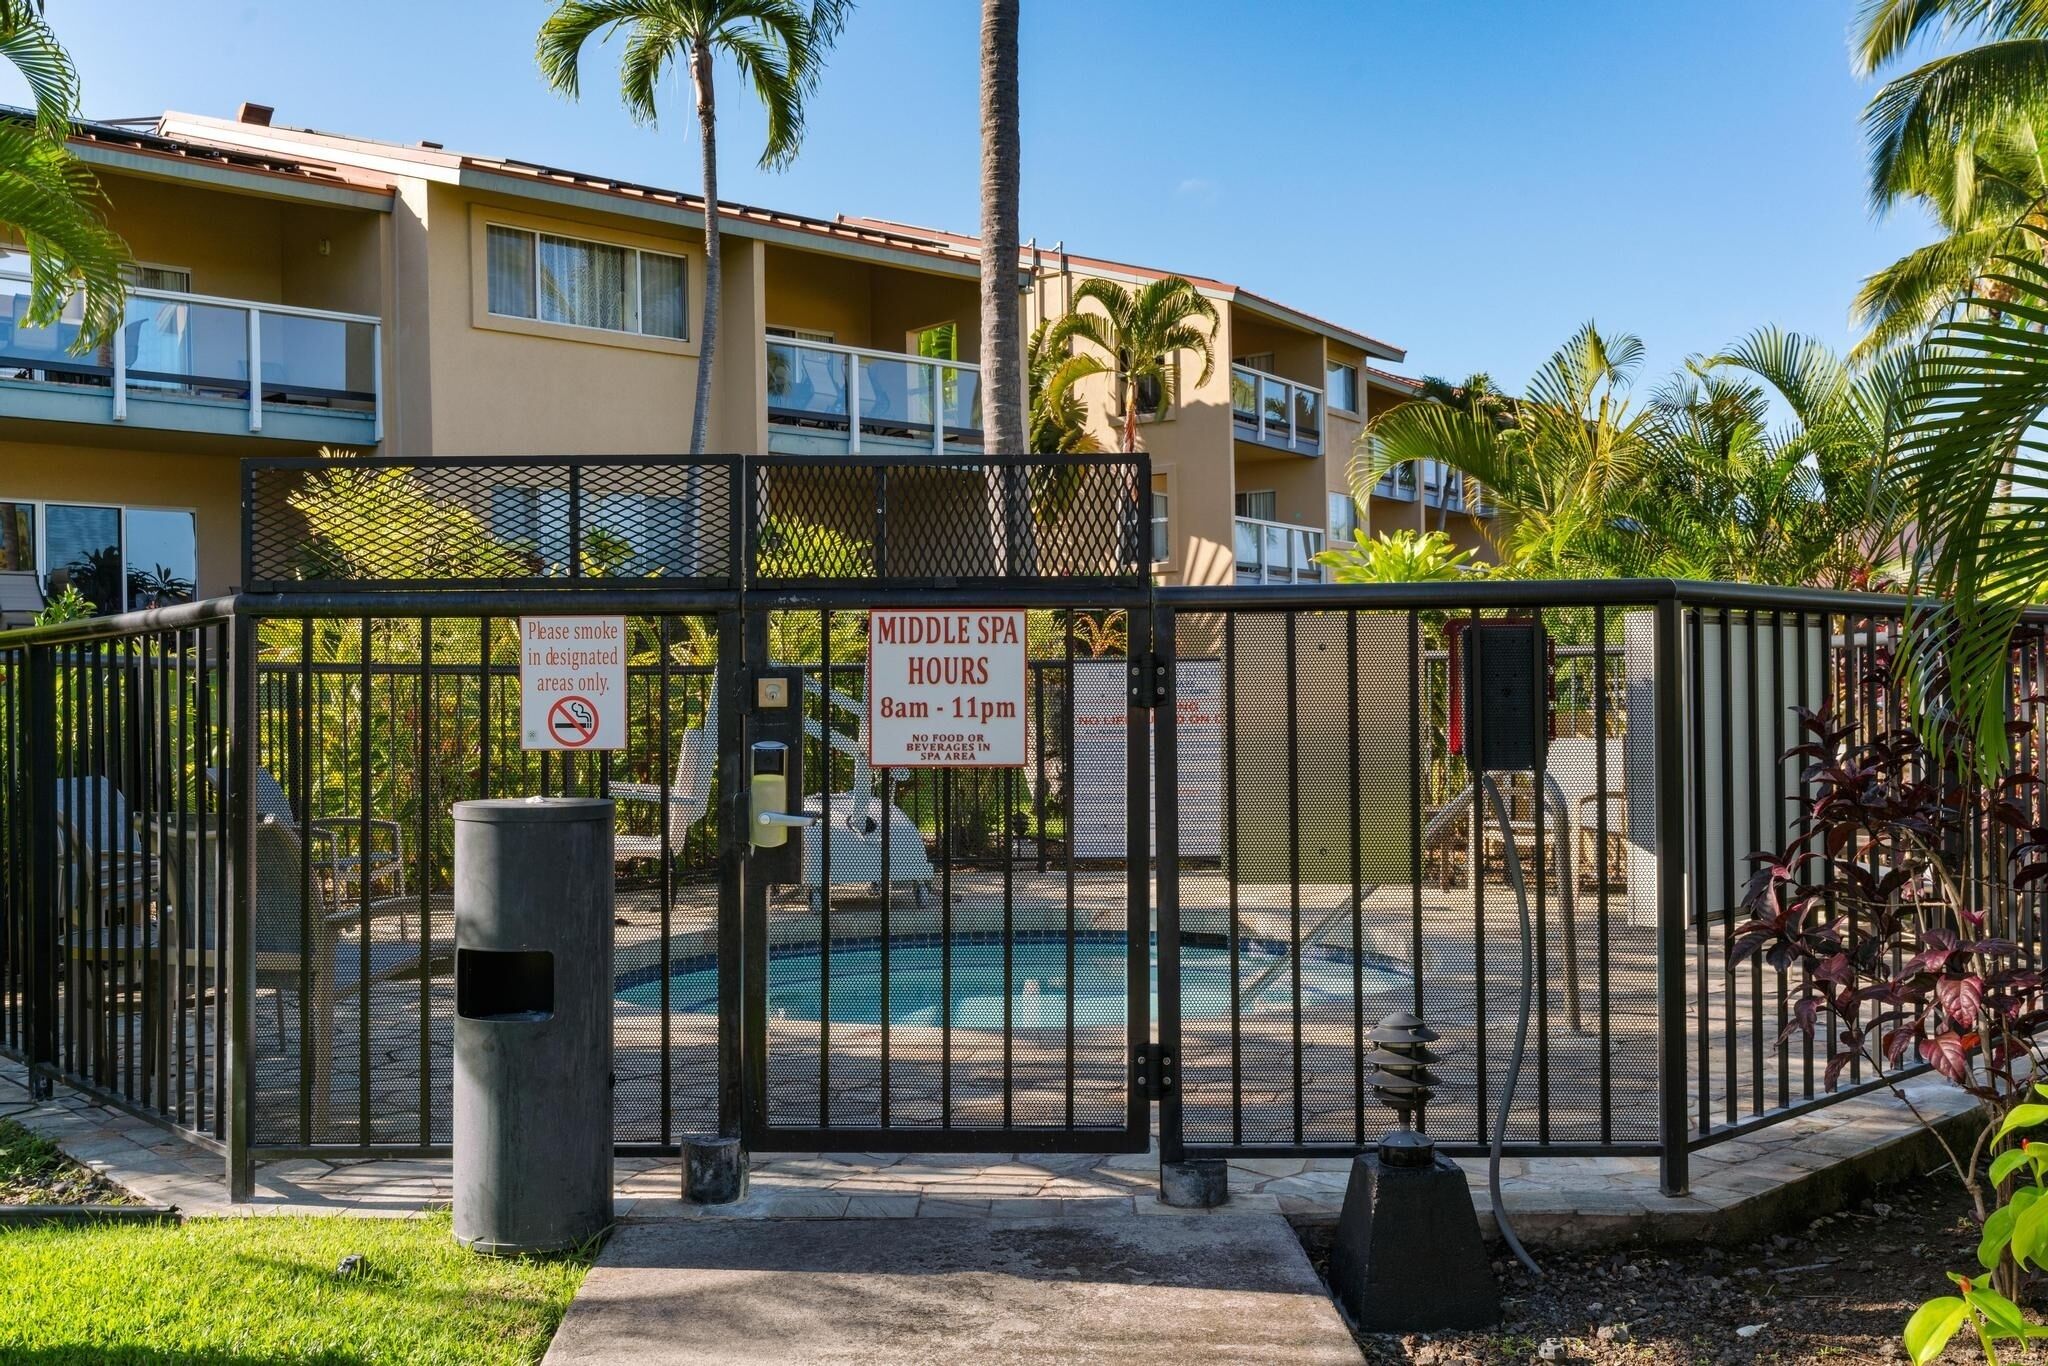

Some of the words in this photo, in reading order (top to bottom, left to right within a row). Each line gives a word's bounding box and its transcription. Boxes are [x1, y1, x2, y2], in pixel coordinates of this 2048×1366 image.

[528, 621, 570, 640] Please
[574, 621, 618, 640] smoke
[878, 616, 970, 644] MIDDLE
[977, 615, 1019, 644] SPA
[528, 648, 541, 666] in
[545, 646, 618, 670] designated
[908, 656, 988, 685] HOURS
[537, 677, 574, 691] areas
[578, 672, 609, 696] only.
[880, 696, 929, 718] 8am
[952, 696, 1016, 724] 11pm
[906, 743, 974, 751] BEVERAGES
[978, 743, 991, 751] IN
[912, 733, 929, 742] NO
[932, 733, 964, 742] FOOD
[968, 733, 984, 742] OR
[920, 752, 941, 761] SPA
[945, 752, 976, 761] AREA
